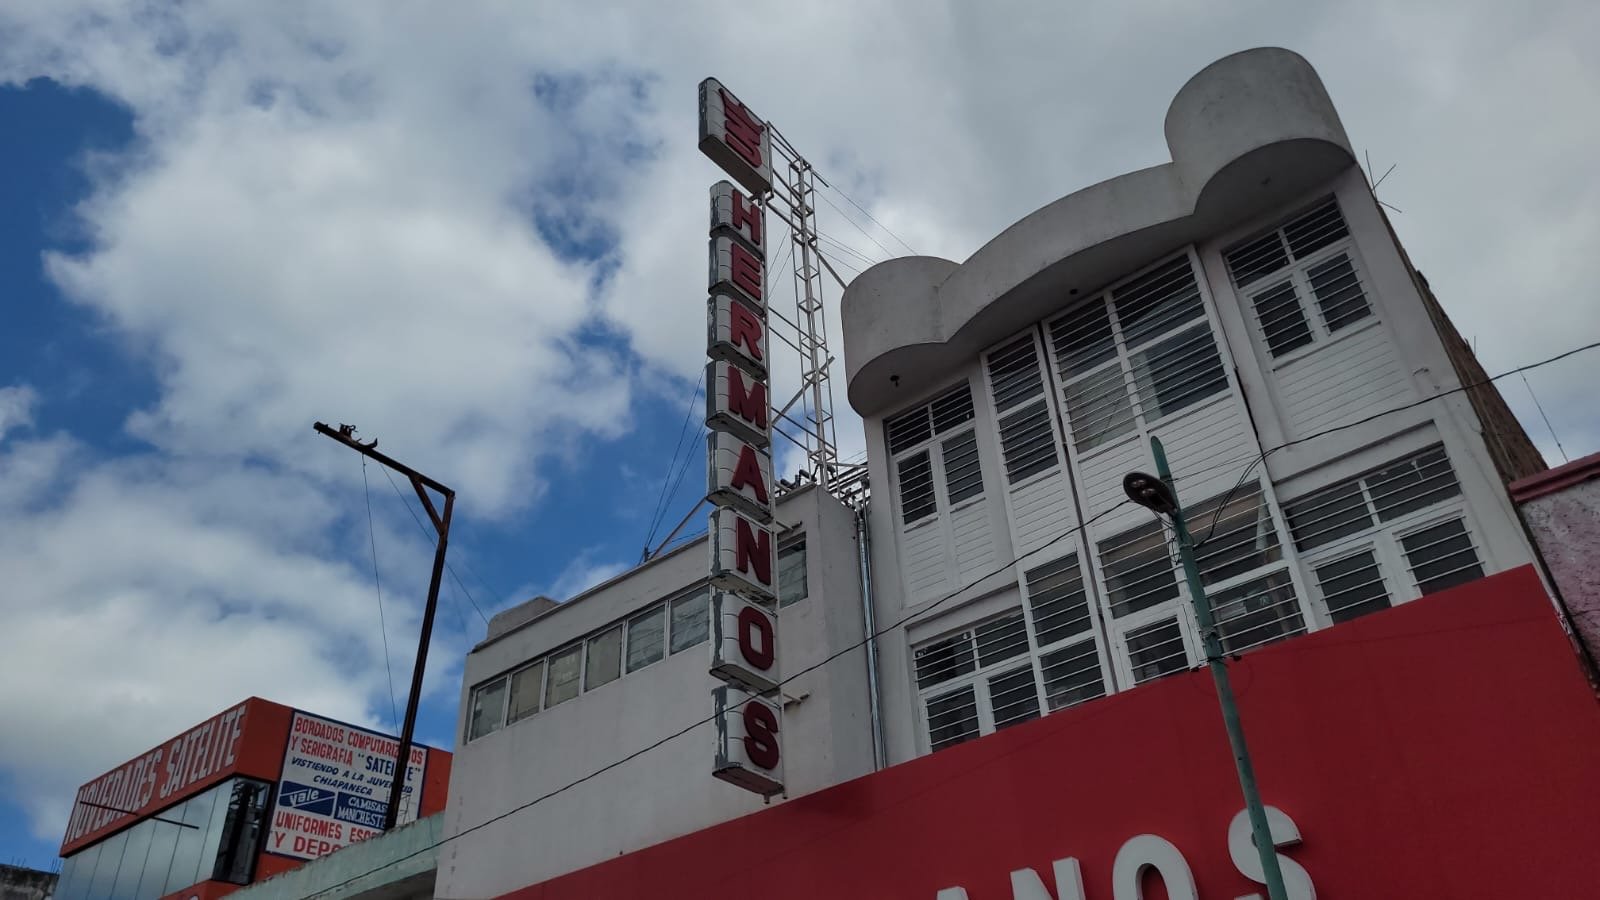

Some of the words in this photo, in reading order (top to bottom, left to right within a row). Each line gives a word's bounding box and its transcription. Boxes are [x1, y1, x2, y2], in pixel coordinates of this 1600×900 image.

[728, 188, 780, 770] HERMANOS
[290, 736, 299, 751] Y
[300, 738, 353, 766] SERIGRAFIA
[295, 717, 344, 743] BORDADOS
[347, 731, 423, 765] COMPUTARIZOS
[64, 749, 163, 844] NOVEDADES
[160, 705, 247, 799] SATELITE
[291, 757, 339, 775] VISTIENDO
[342, 770, 349, 778] A
[352, 772, 364, 781] LA
[313, 775, 372, 796] CHIAPANECA
[337, 806, 386, 828] MANCHESTE
[348, 796, 388, 813] CAMISAS
[275, 812, 342, 839] UNIFORMES
[274, 831, 286, 848] Y
